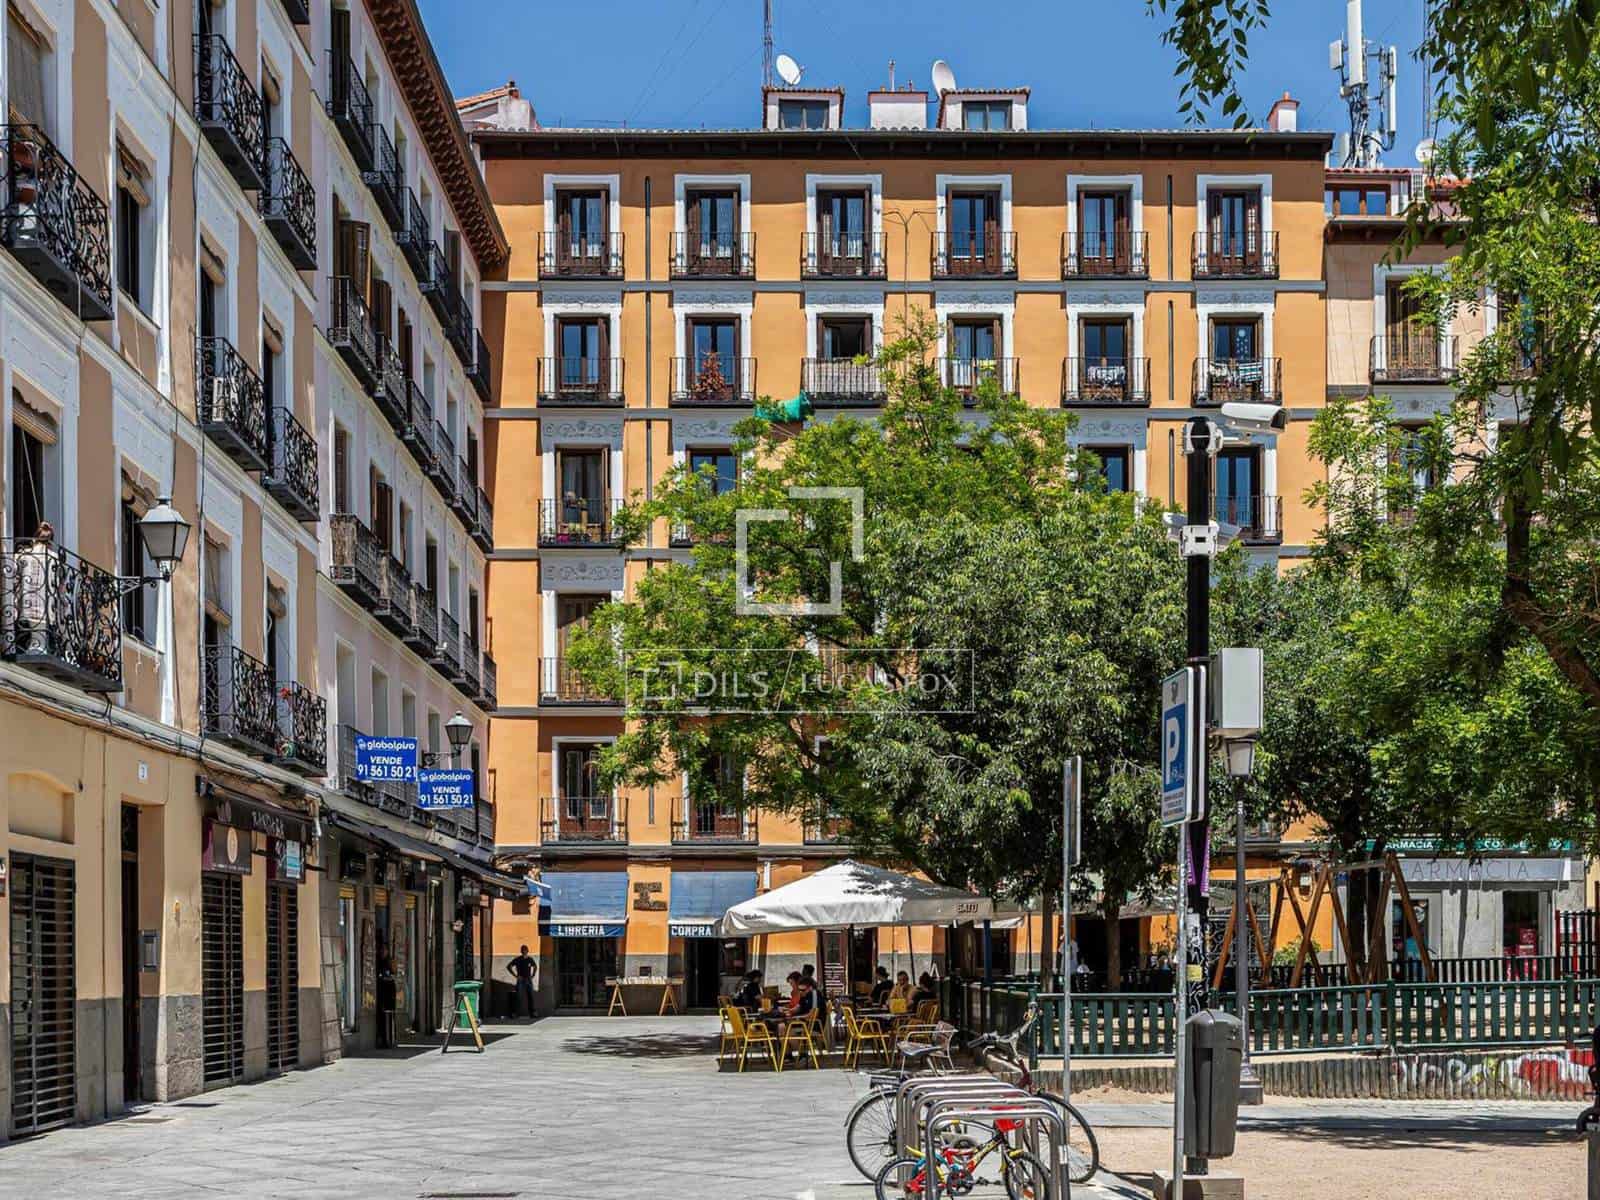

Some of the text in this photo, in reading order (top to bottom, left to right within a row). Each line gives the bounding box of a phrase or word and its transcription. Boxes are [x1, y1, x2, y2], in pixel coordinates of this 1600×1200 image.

[367, 739, 416, 751] globalpiso
[1165, 716, 1180, 785] P
[370, 755, 403, 765] VENDE
[358, 764, 417, 778] 91 561 50 21
[432, 786, 461, 794] VENDE
[420, 794, 473, 804] 91 561 50 21
[1410, 860, 1529, 880] ARMACIA
[671, 925, 712, 936] COMPRA
